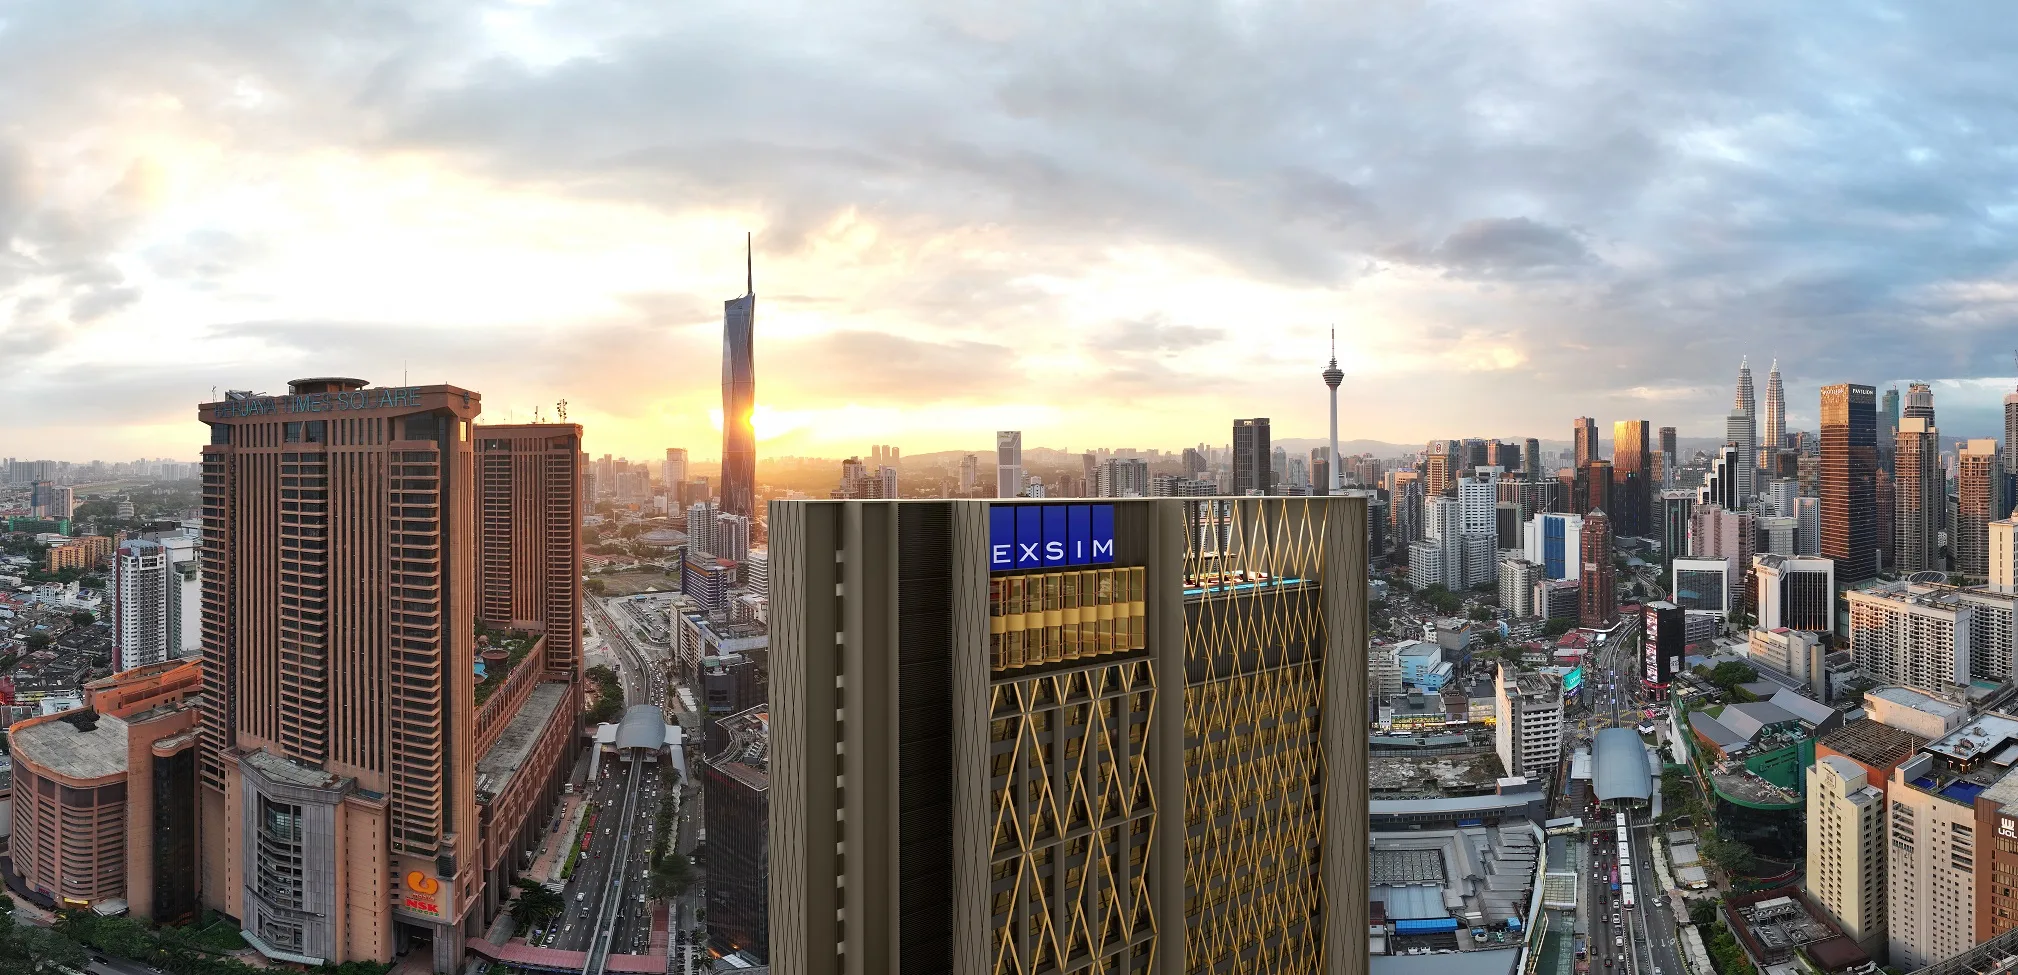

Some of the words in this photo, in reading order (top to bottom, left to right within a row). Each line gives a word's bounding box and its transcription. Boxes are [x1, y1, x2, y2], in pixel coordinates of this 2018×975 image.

[214, 397, 277, 418] BERJAYA
[282, 392, 333, 413] TIMES
[337, 387, 421, 411] SQUARE
[993, 538, 1113, 564] EXSIM
[1998, 827, 2018, 839] UOL
[406, 899, 438, 912] NSK
